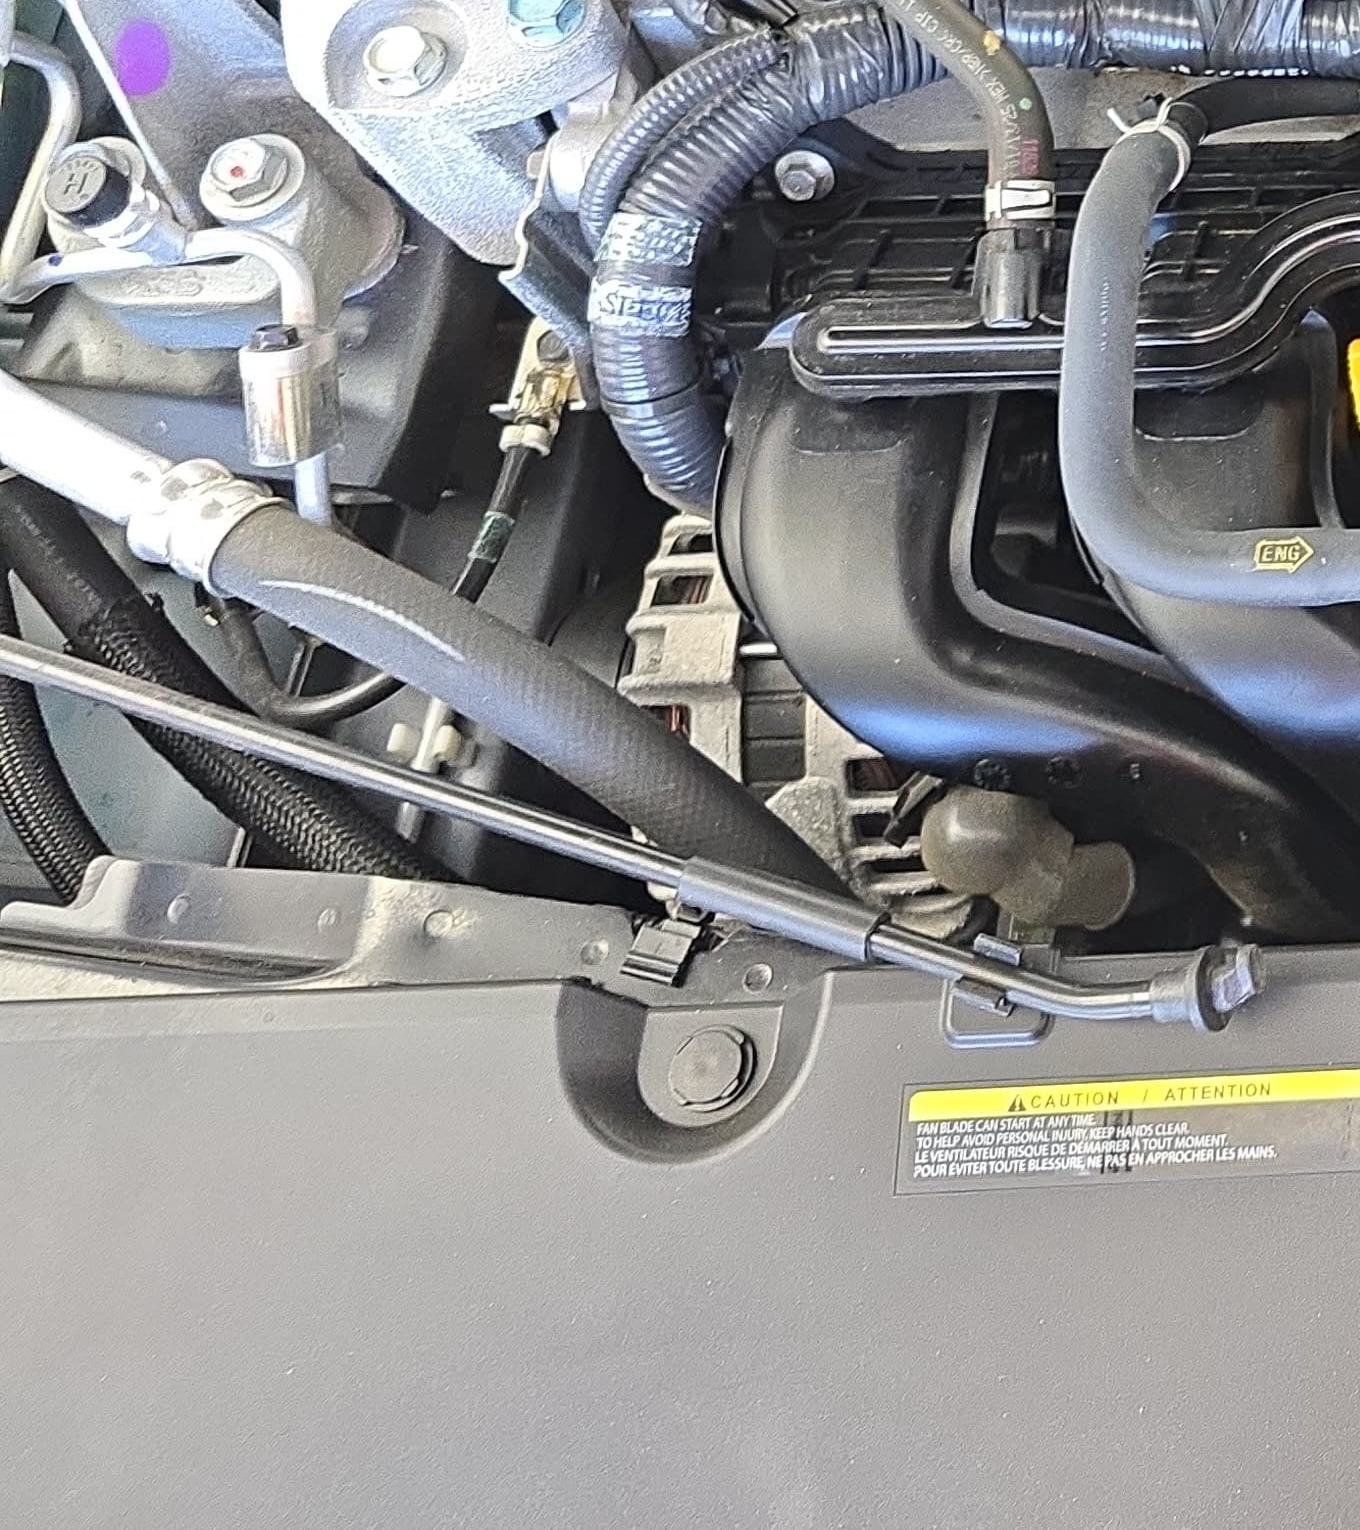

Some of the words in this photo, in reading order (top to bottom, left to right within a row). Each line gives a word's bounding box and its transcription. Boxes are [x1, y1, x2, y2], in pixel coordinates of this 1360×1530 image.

[913, 9, 939, 34] CIP
[983, 74, 1012, 105] MEX
[1260, 543, 1301, 564] ENG
[1030, 1090, 1120, 1109] CAUTION
[1141, 1088, 1150, 1103] /
[1164, 1082, 1273, 1103] ATTENTION
[916, 1122, 939, 1137] FAN
[940, 1120, 973, 1135] BLADE
[974, 1118, 998, 1133] CAN
[999, 1117, 1031, 1131] START
[1033, 1116, 1046, 1130] AT
[1046, 1115, 1070, 1129] ANY
[916, 1135, 932, 1150] TO
[933, 1134, 960, 1149] HELP
[961, 1132, 995, 1147] AVOID
[996, 1129, 1050, 1145] PERSONAL
[1089, 1125, 1115, 1140] KEEP
[1116, 1123, 1154, 1139] HANDS
[914, 1164, 948, 1179] POUR
[949, 1160, 987, 1177] ÉVITER
[988, 1159, 1027, 1174] TOUTE
[1086, 1155, 1103, 1169] NE
[1103, 1153, 1127, 1168] PAS
[1127, 1151, 1145, 1167] EN
[1145, 1148, 1215, 1166] APPROCHER
[1215, 1147, 1236, 1162] LES
[1236, 1144, 1279, 1161] MAINS.
[915, 1149, 930, 1164] LE
[930, 1145, 1006, 1163] VENTILATEUR
[1007, 1143, 1049, 1158] RISQUE
[1050, 1141, 1067, 1155] DE
[1068, 1138, 1130, 1156] DÉMARRER
[1142, 1136, 1174, 1151] TOUT
[1174, 1133, 1229, 1149] MOMENT.
